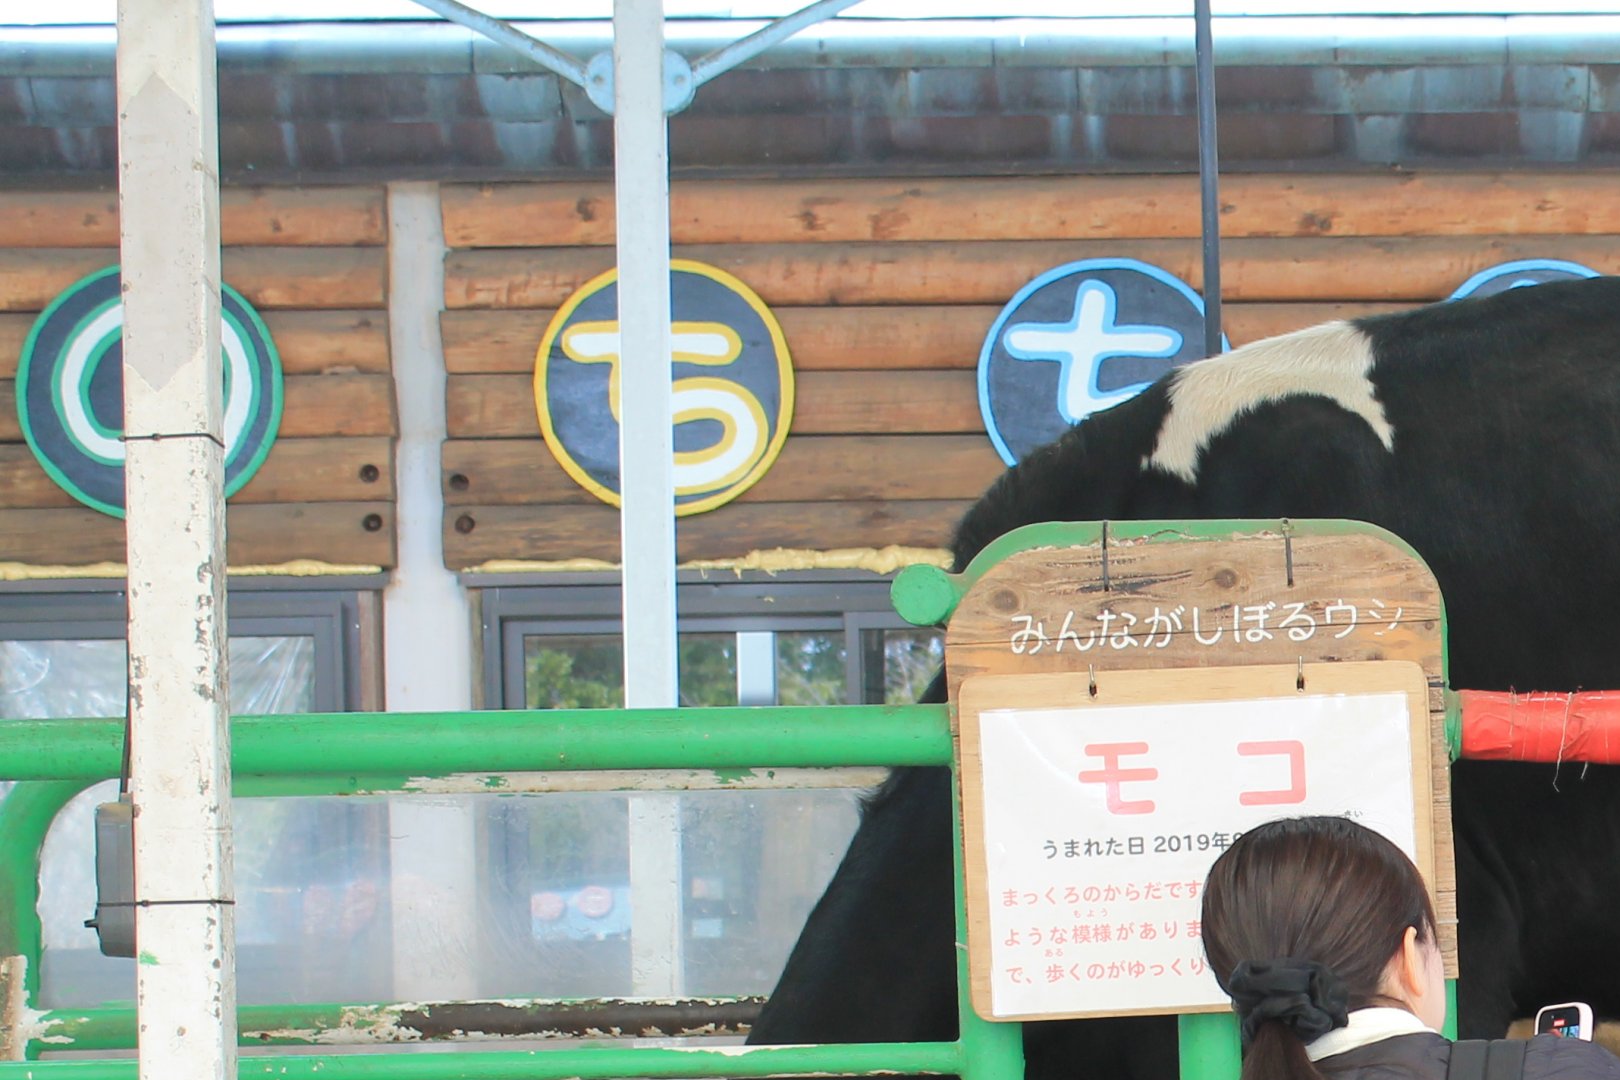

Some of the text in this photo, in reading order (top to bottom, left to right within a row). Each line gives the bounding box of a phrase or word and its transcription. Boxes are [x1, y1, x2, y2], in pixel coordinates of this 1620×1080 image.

[1009, 598, 1403, 656] みんながしぼるウシ
[1042, 836, 1146, 861] うまれた日
[1001, 878, 1204, 908] まっくろのからだです
[1073, 908, 1109, 919] もよう
[1004, 920, 1204, 948] ような模様がありま
[1044, 948, 1065, 958] ある
[1005, 957, 1206, 986] で、歩くのがゆっくり
